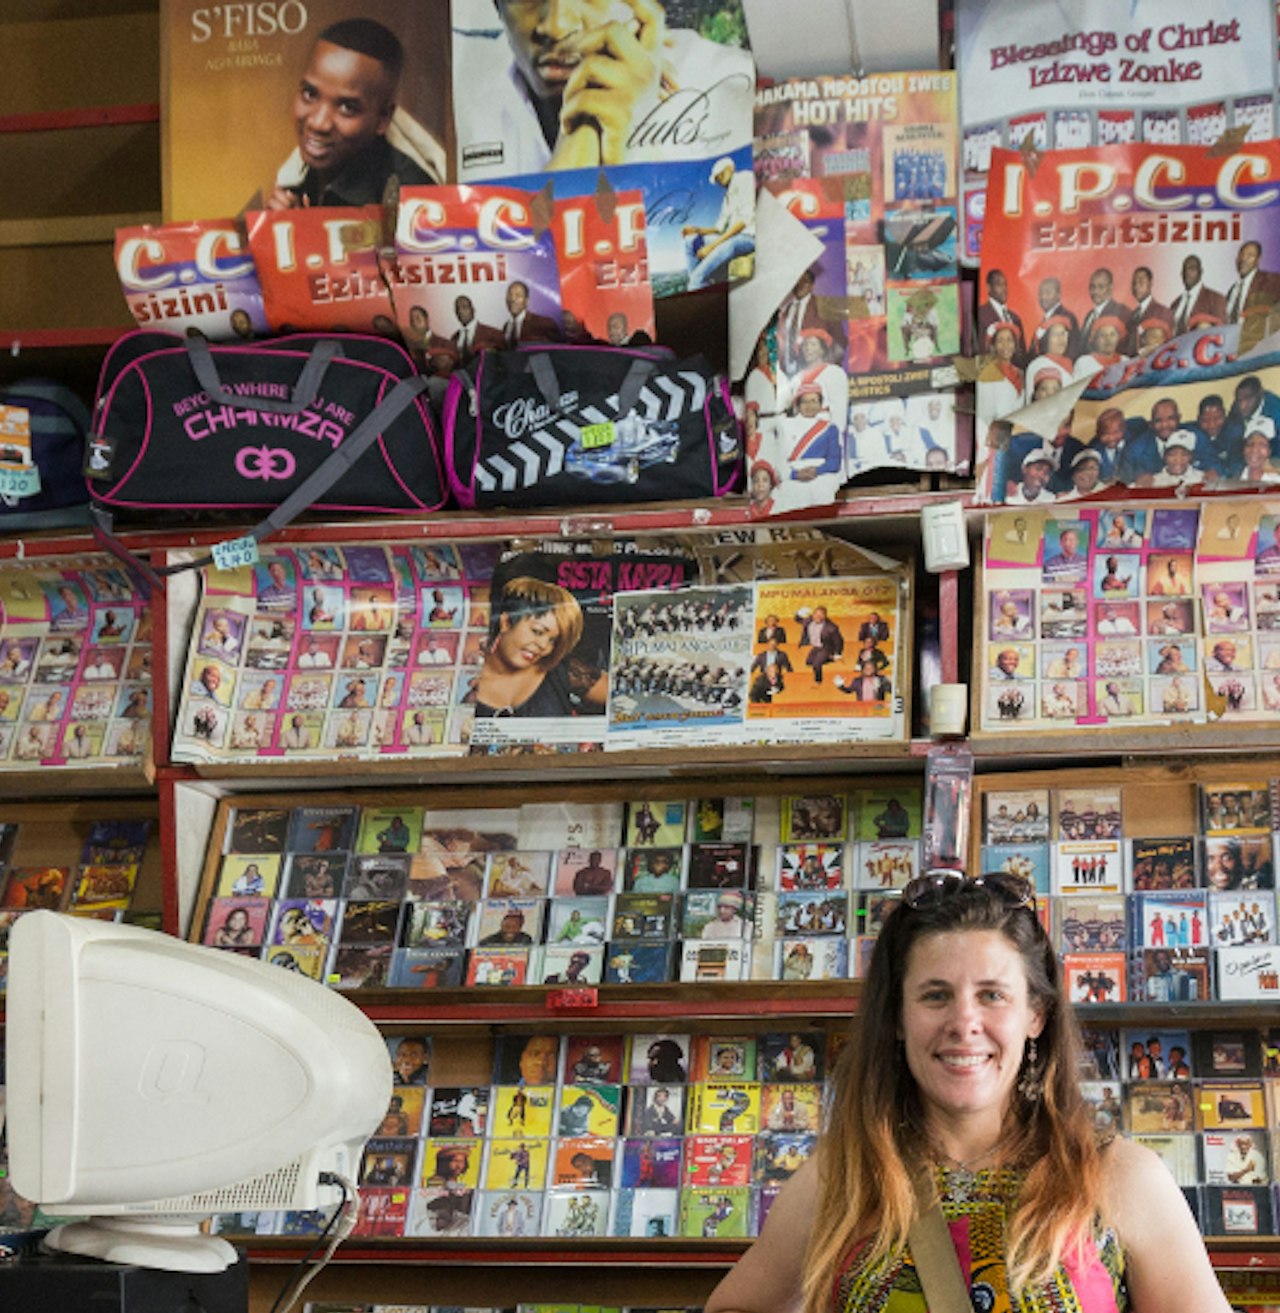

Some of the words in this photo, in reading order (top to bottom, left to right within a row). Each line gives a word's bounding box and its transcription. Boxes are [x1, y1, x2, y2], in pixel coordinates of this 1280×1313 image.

[990, 30, 1118, 71] Blessings
[1123, 28, 1152, 53] of
[1157, 18, 1241, 52] Christ
[908, 75, 951, 92] ZWEE
[1028, 61, 1111, 90] Izizwe
[1119, 57, 1203, 83] Zonke
[793, 101, 840, 125] HOT
[845, 98, 898, 122] HITS
[1033, 212, 1242, 250] Ezintsizini
[234, 383, 288, 399] WHERE
[325, 401, 355, 426] ARE
[557, 561, 612, 589] SISTA
[618, 563, 684, 591] KAPPA
[760, 586, 859, 598] MPUMALANGA
